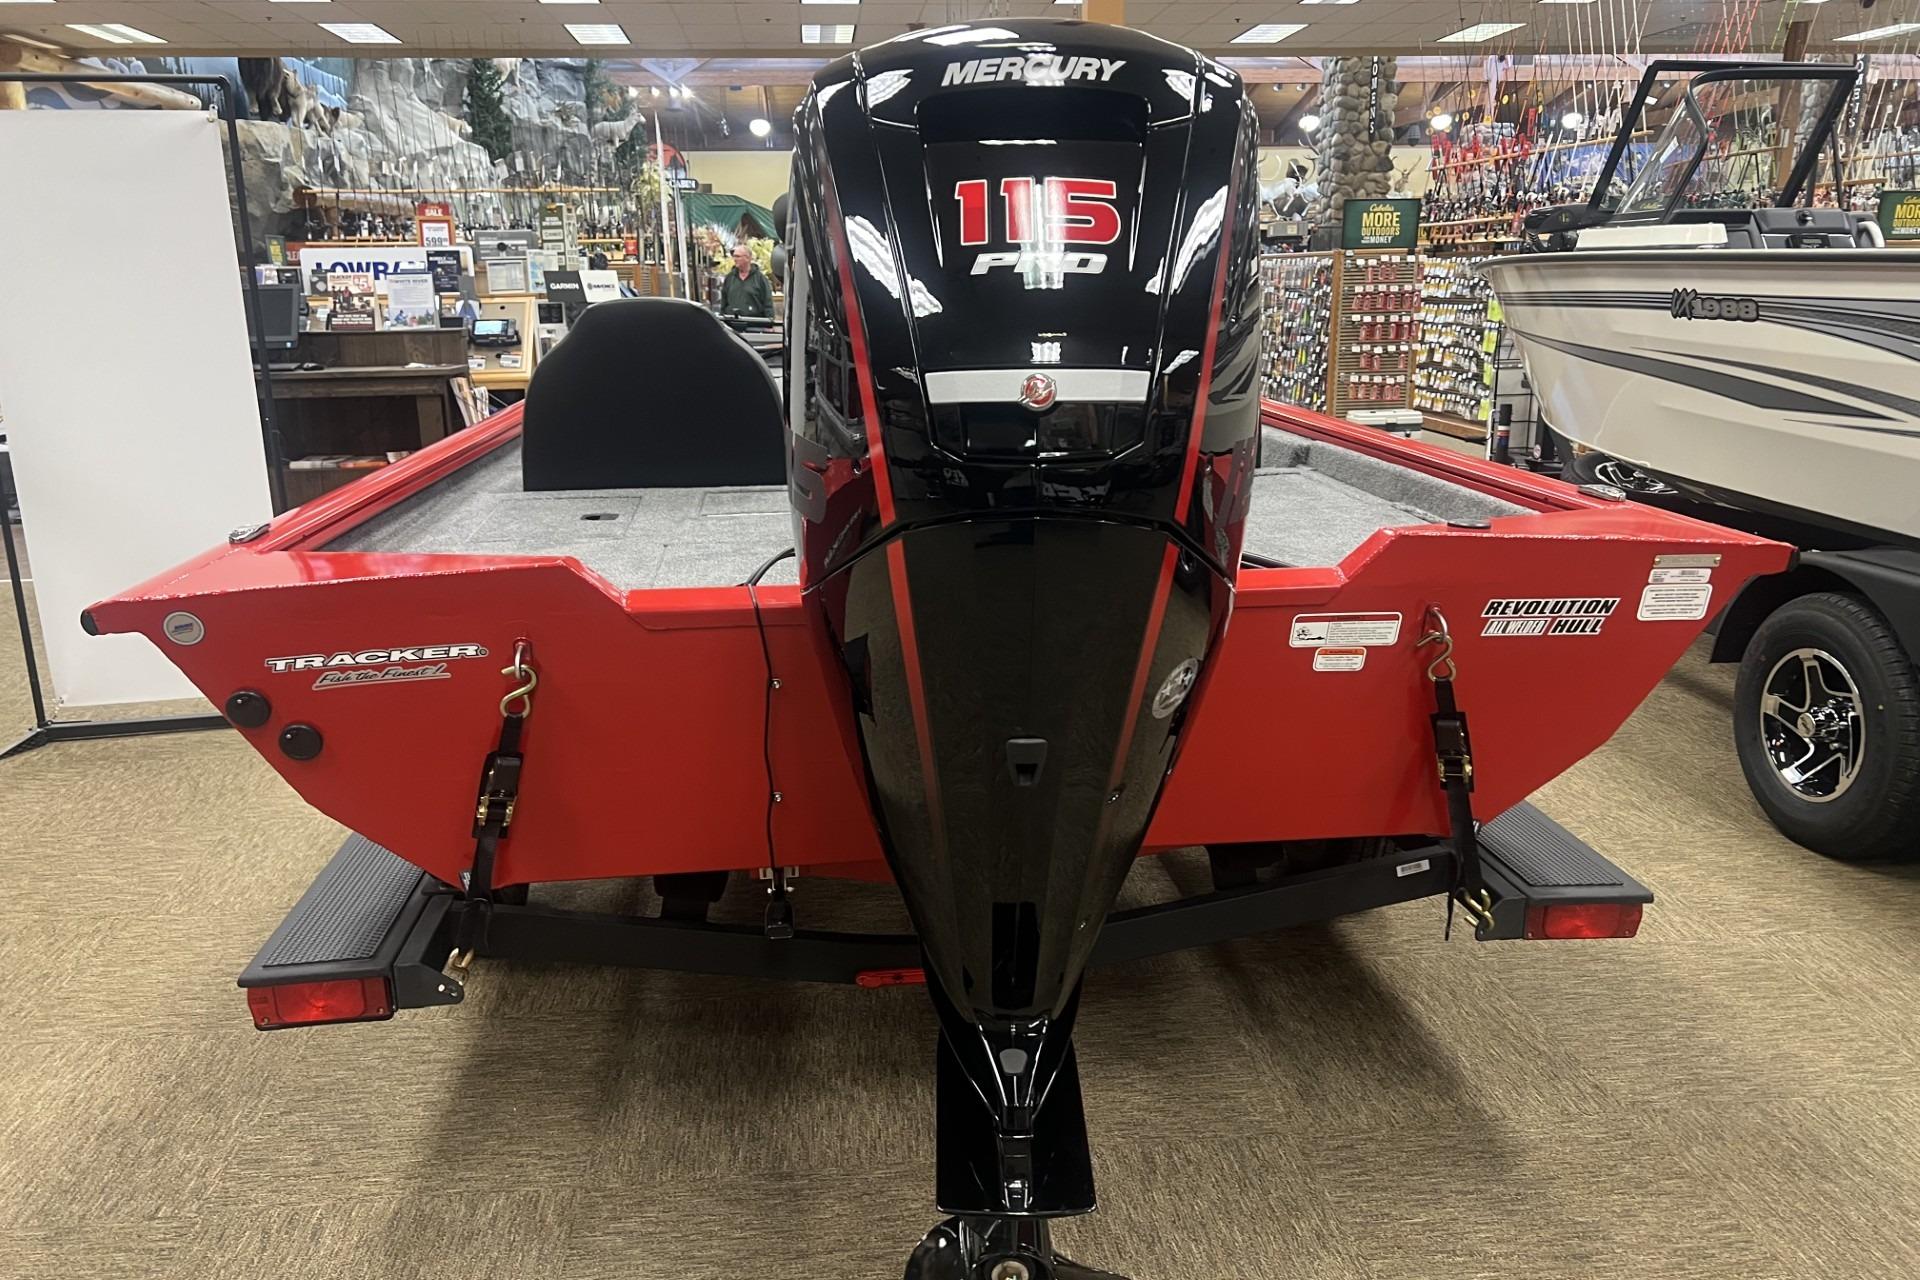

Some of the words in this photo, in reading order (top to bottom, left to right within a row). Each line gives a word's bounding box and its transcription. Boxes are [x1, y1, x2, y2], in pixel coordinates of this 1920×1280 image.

[941, 55, 1126, 86] MERCURY
[955, 176, 1121, 245] 115
[1895, 204, 1920, 219] MOR
[1362, 211, 1400, 227] MORE
[1361, 226, 1400, 236] OUTDOORS
[550, 282, 579, 290] GARMIN
[1483, 599, 1618, 615] REVOLUTION
[1550, 619, 1602, 634] HULL
[267, 644, 481, 672] TRACKER
[319, 672, 352, 684] Fish
[355, 670, 379, 681] the
